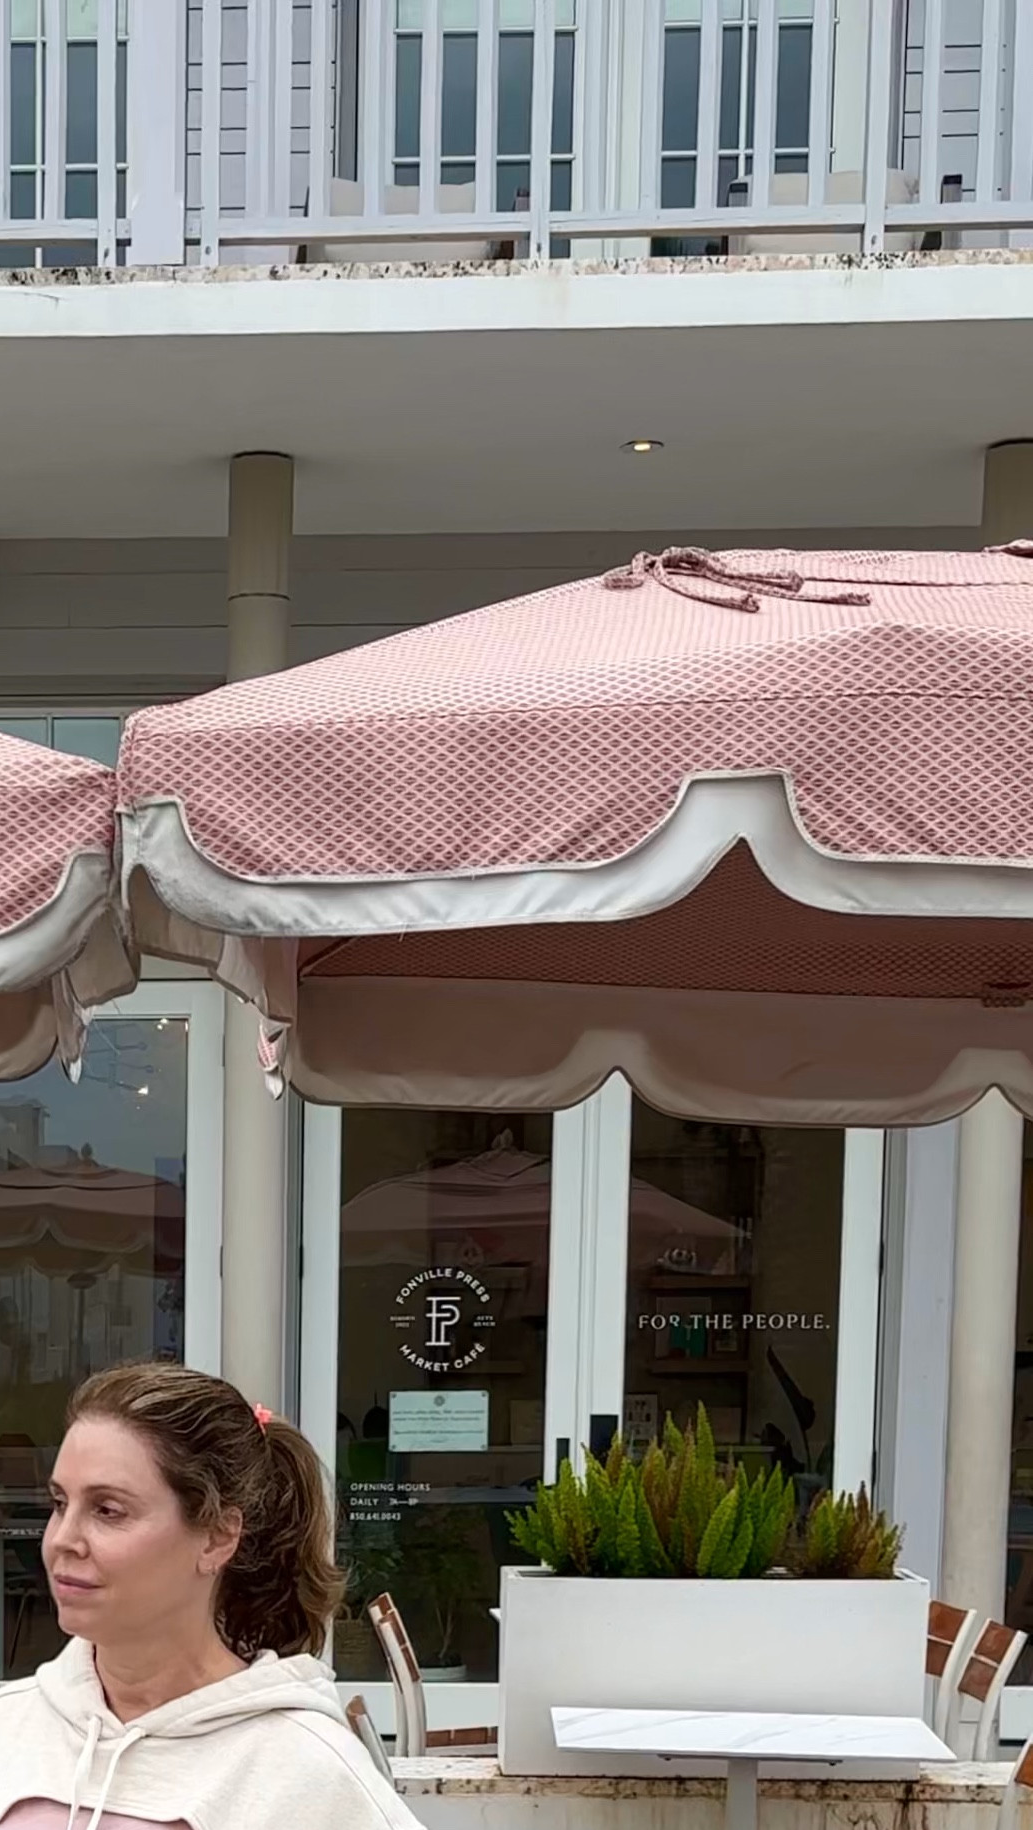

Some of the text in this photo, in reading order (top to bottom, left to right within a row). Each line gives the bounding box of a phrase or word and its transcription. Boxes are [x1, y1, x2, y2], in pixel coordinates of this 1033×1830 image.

[396, 1268, 490, 1304] FONVILLE PRESS
[638, 1313, 831, 1329] FOR THE PEOPLE.
[399, 1344, 449, 1371] MARKET
[350, 1483, 431, 1491] OPENING HOURS
[350, 1497, 379, 1506] DAILY
